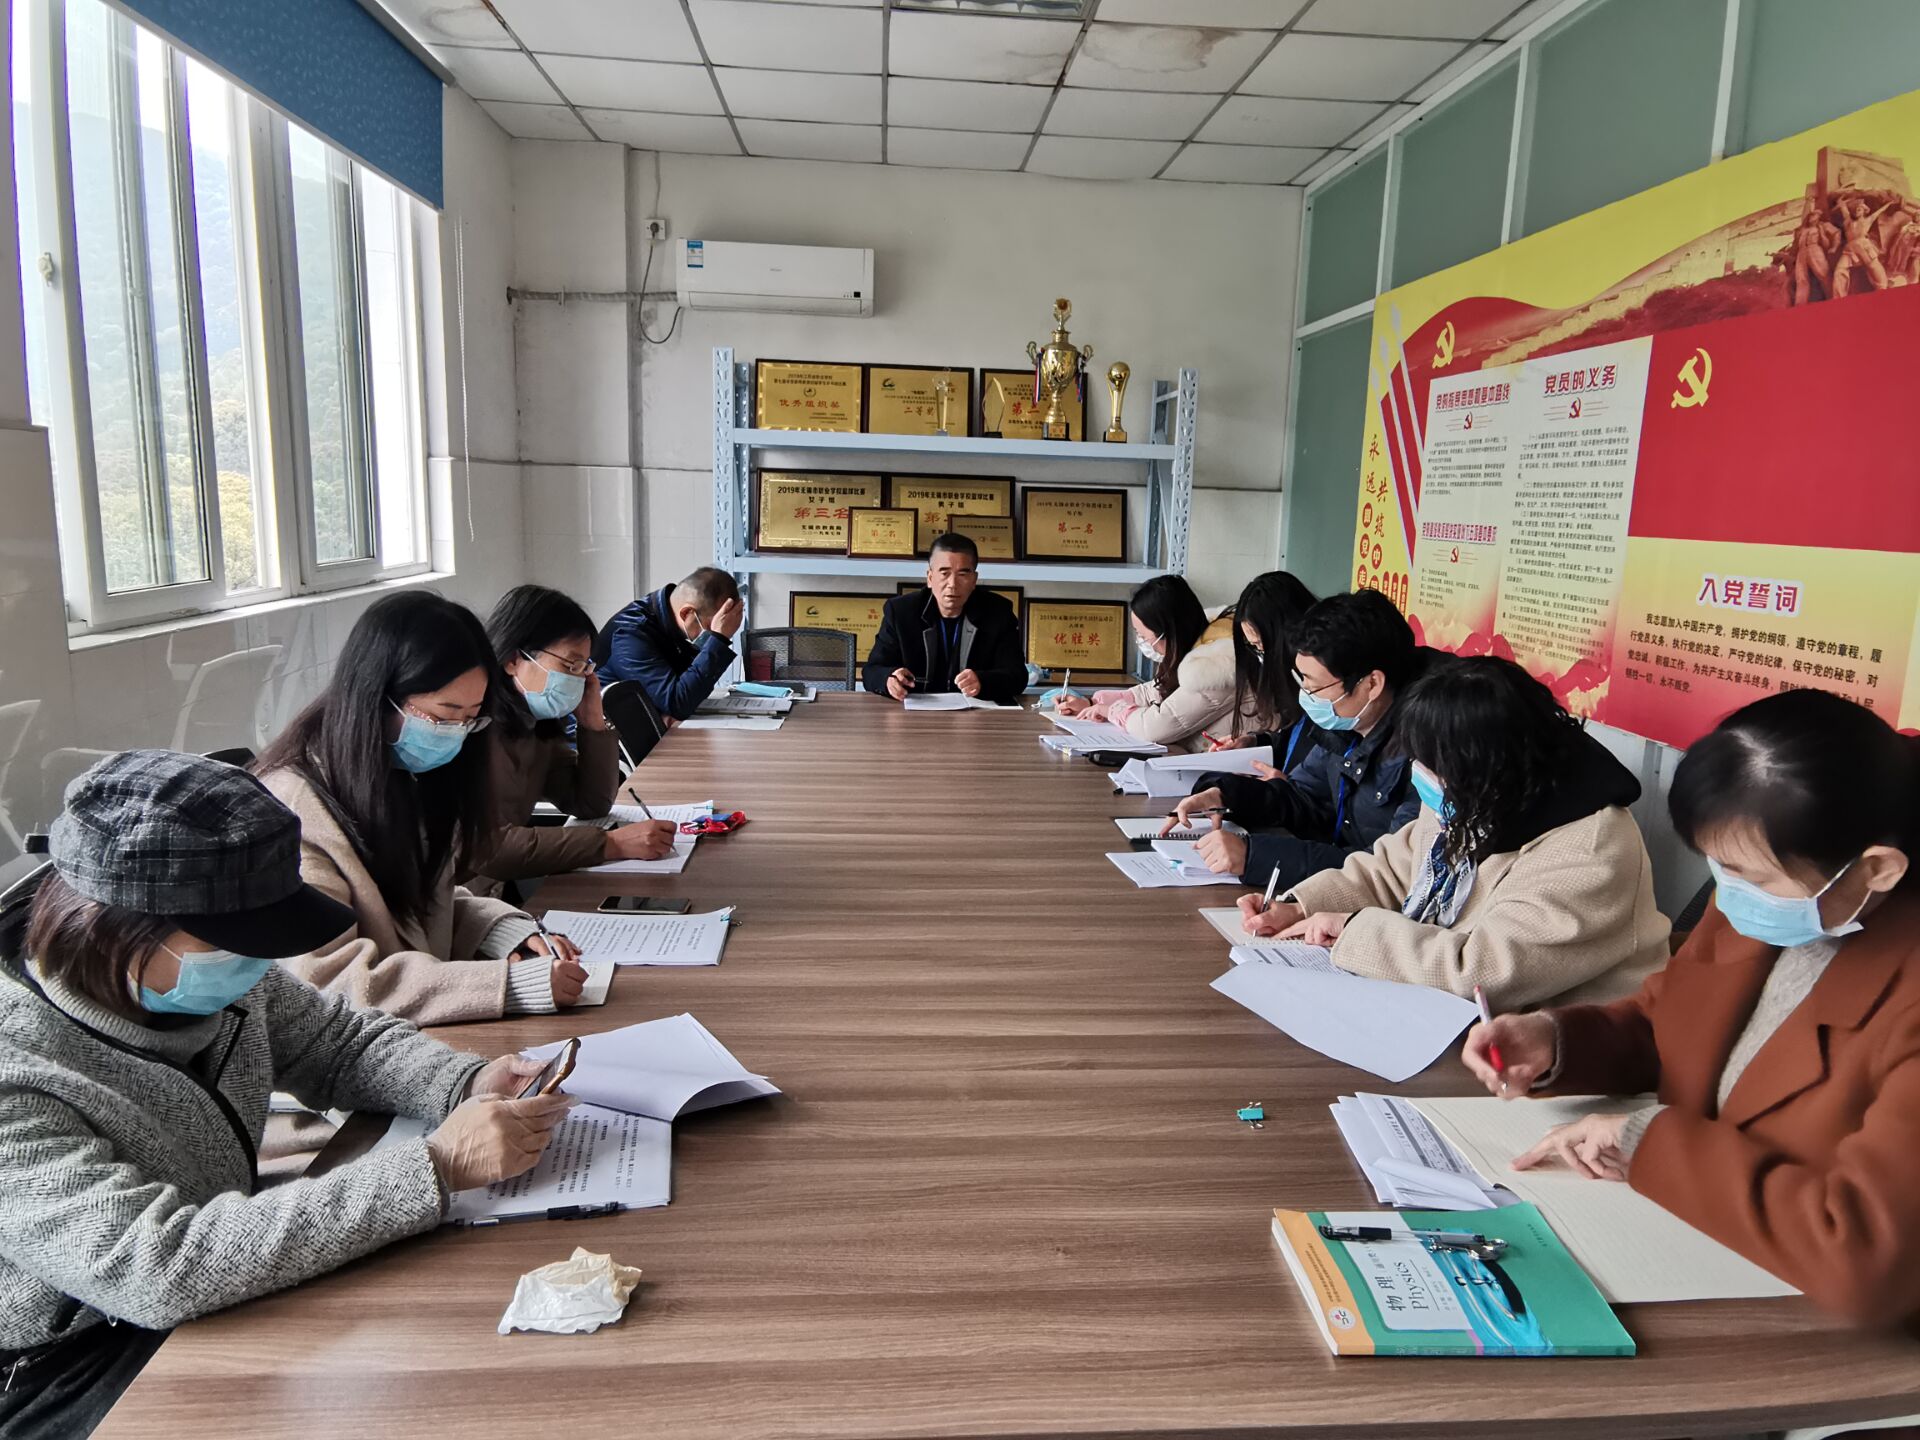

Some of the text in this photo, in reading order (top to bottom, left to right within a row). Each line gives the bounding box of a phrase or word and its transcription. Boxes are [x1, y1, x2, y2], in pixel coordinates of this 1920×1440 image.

[1544, 364, 1616, 395] 党员的义务
[1436, 383, 1511, 410] 党的指导思想和基本路线
[777, 486, 866, 496] 2019年无锡市职业学校篮球比赛
[907, 490, 995, 501] 2019年无锡市职业学校篮球比赛
[938, 501, 965, 509] 男子组
[794, 506, 849, 519] 第三名
[1057, 521, 1094, 535] 第一名
[1698, 577, 1799, 613] 入党誓词
[1054, 632, 1101, 646] 优胜奖
[1394, 1262, 1430, 1311] Physics
[1374, 1276, 1407, 1312] 物理
